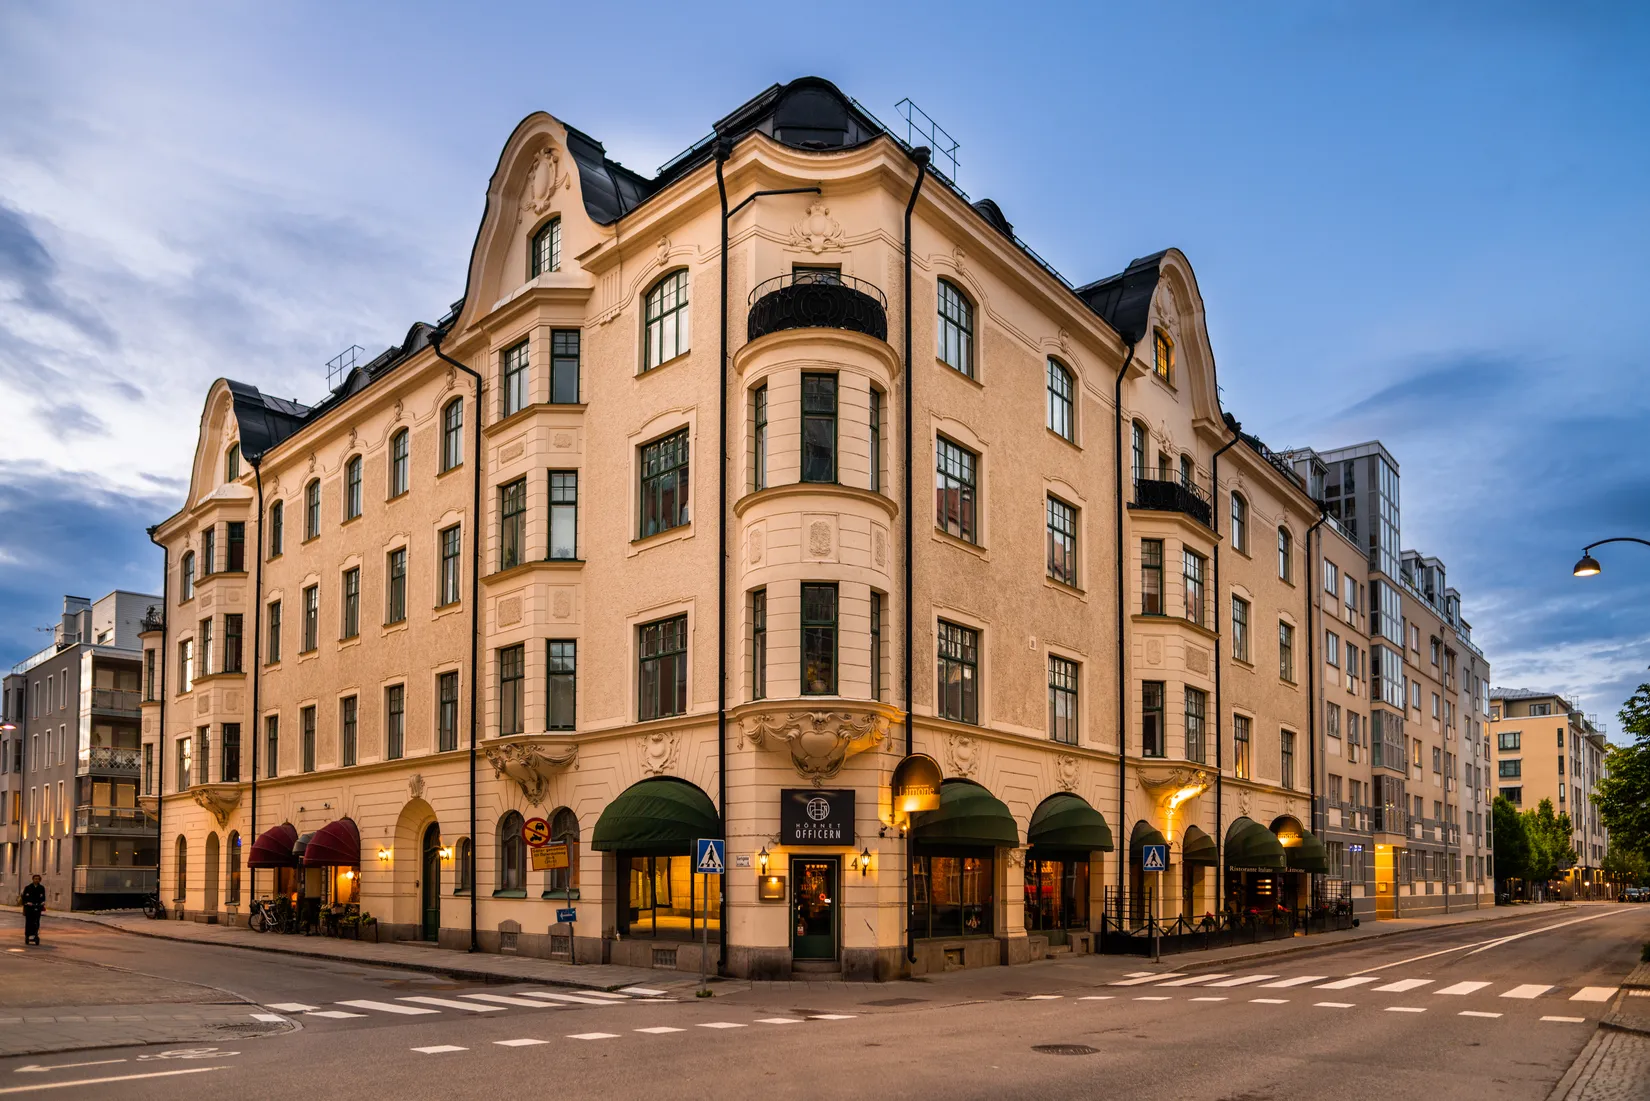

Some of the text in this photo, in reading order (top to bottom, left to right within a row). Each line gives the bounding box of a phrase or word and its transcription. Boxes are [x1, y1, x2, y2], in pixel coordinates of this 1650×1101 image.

[899, 786, 935, 796] Limone
[795, 830, 840, 838] OFFICERN
[851, 858, 857, 870] 4
